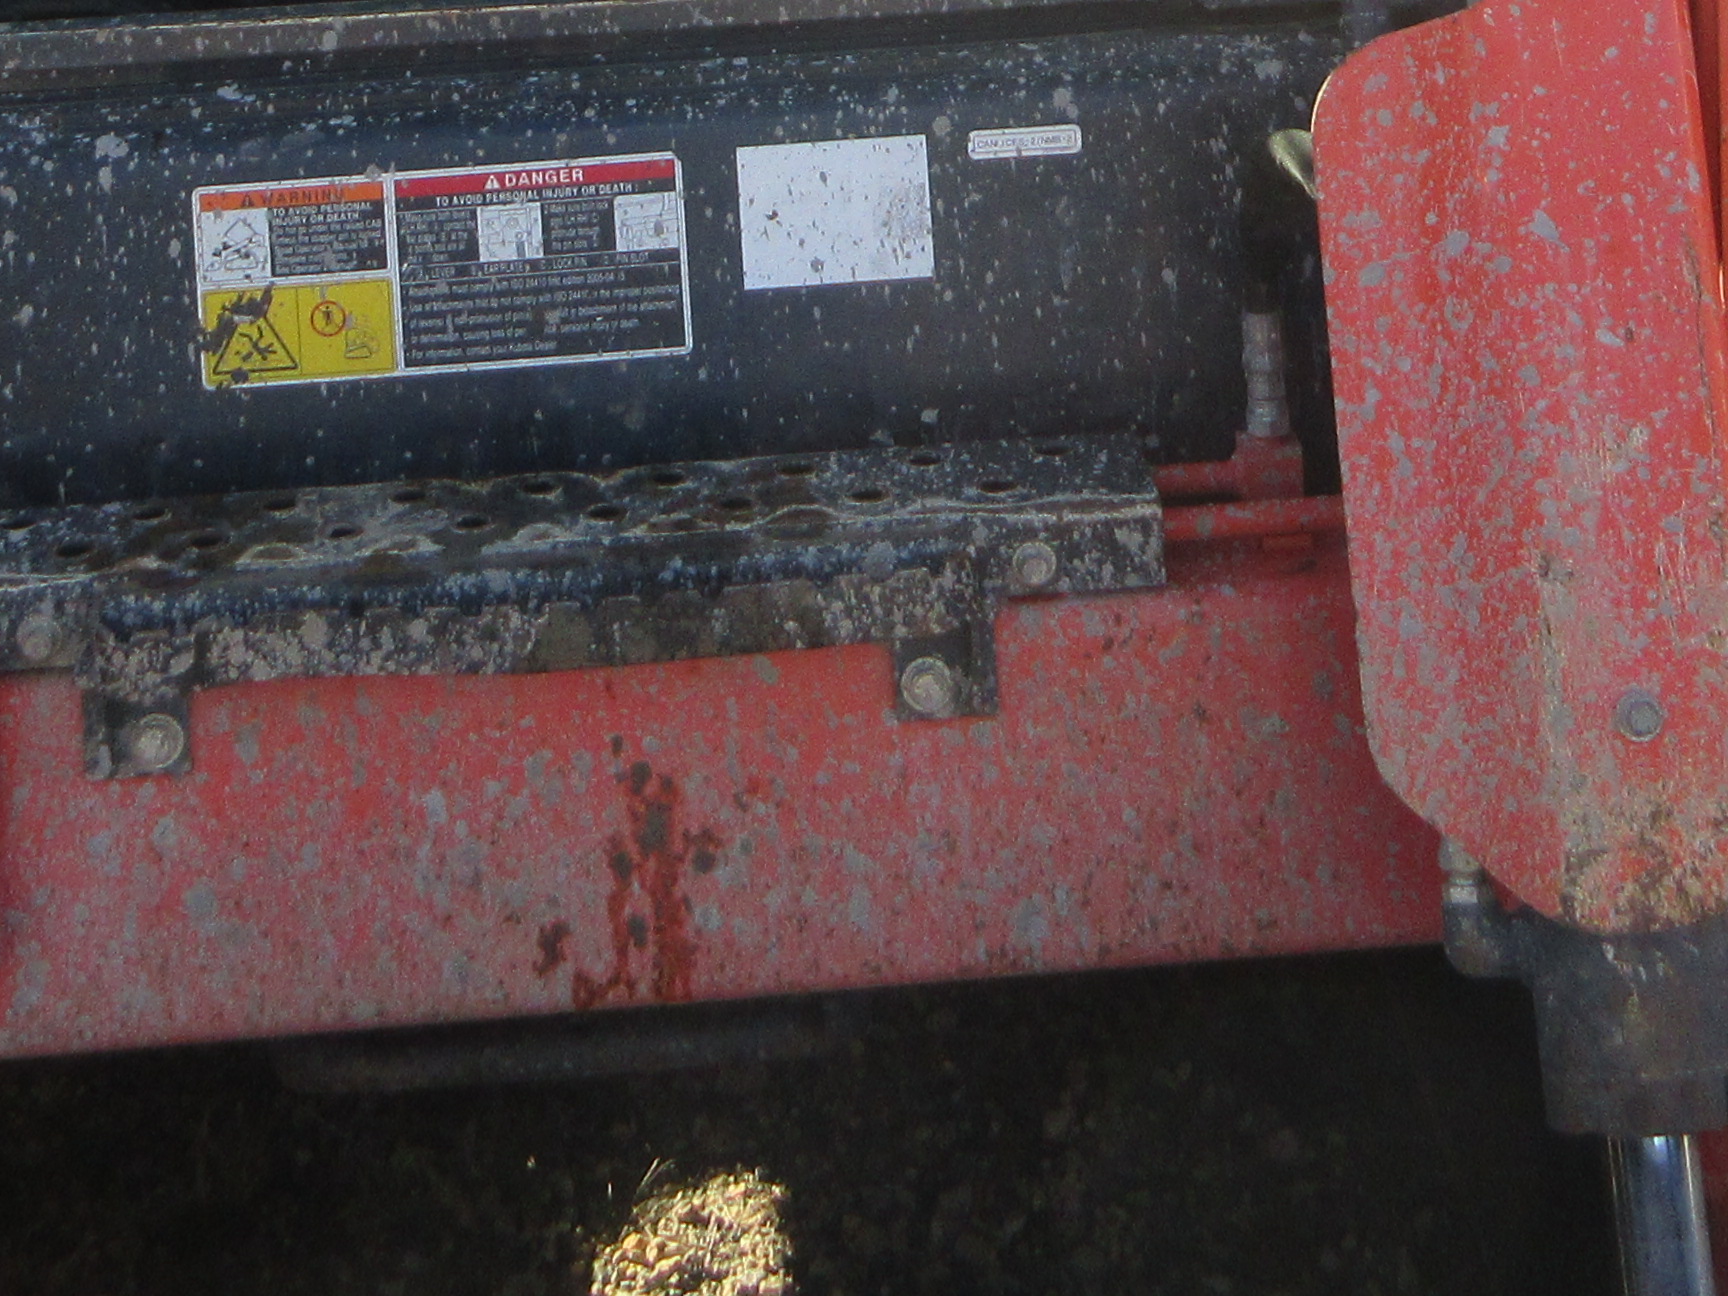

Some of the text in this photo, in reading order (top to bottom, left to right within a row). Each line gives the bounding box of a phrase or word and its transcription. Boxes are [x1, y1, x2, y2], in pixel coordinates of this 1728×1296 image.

[505, 168, 584, 187] DANGER
[436, 196, 449, 207] TO
[452, 193, 483, 206] AVOID
[486, 189, 539, 203] PERSONAL
[542, 186, 578, 198] INJURY
[581, 185, 595, 196] OR
[599, 182, 633, 194] DEATH
[273, 202, 372, 216] TO AVOID PERSONAL
[273, 211, 359, 226] INJURY OR DEATH
[432, 266, 455, 279] LEVER
